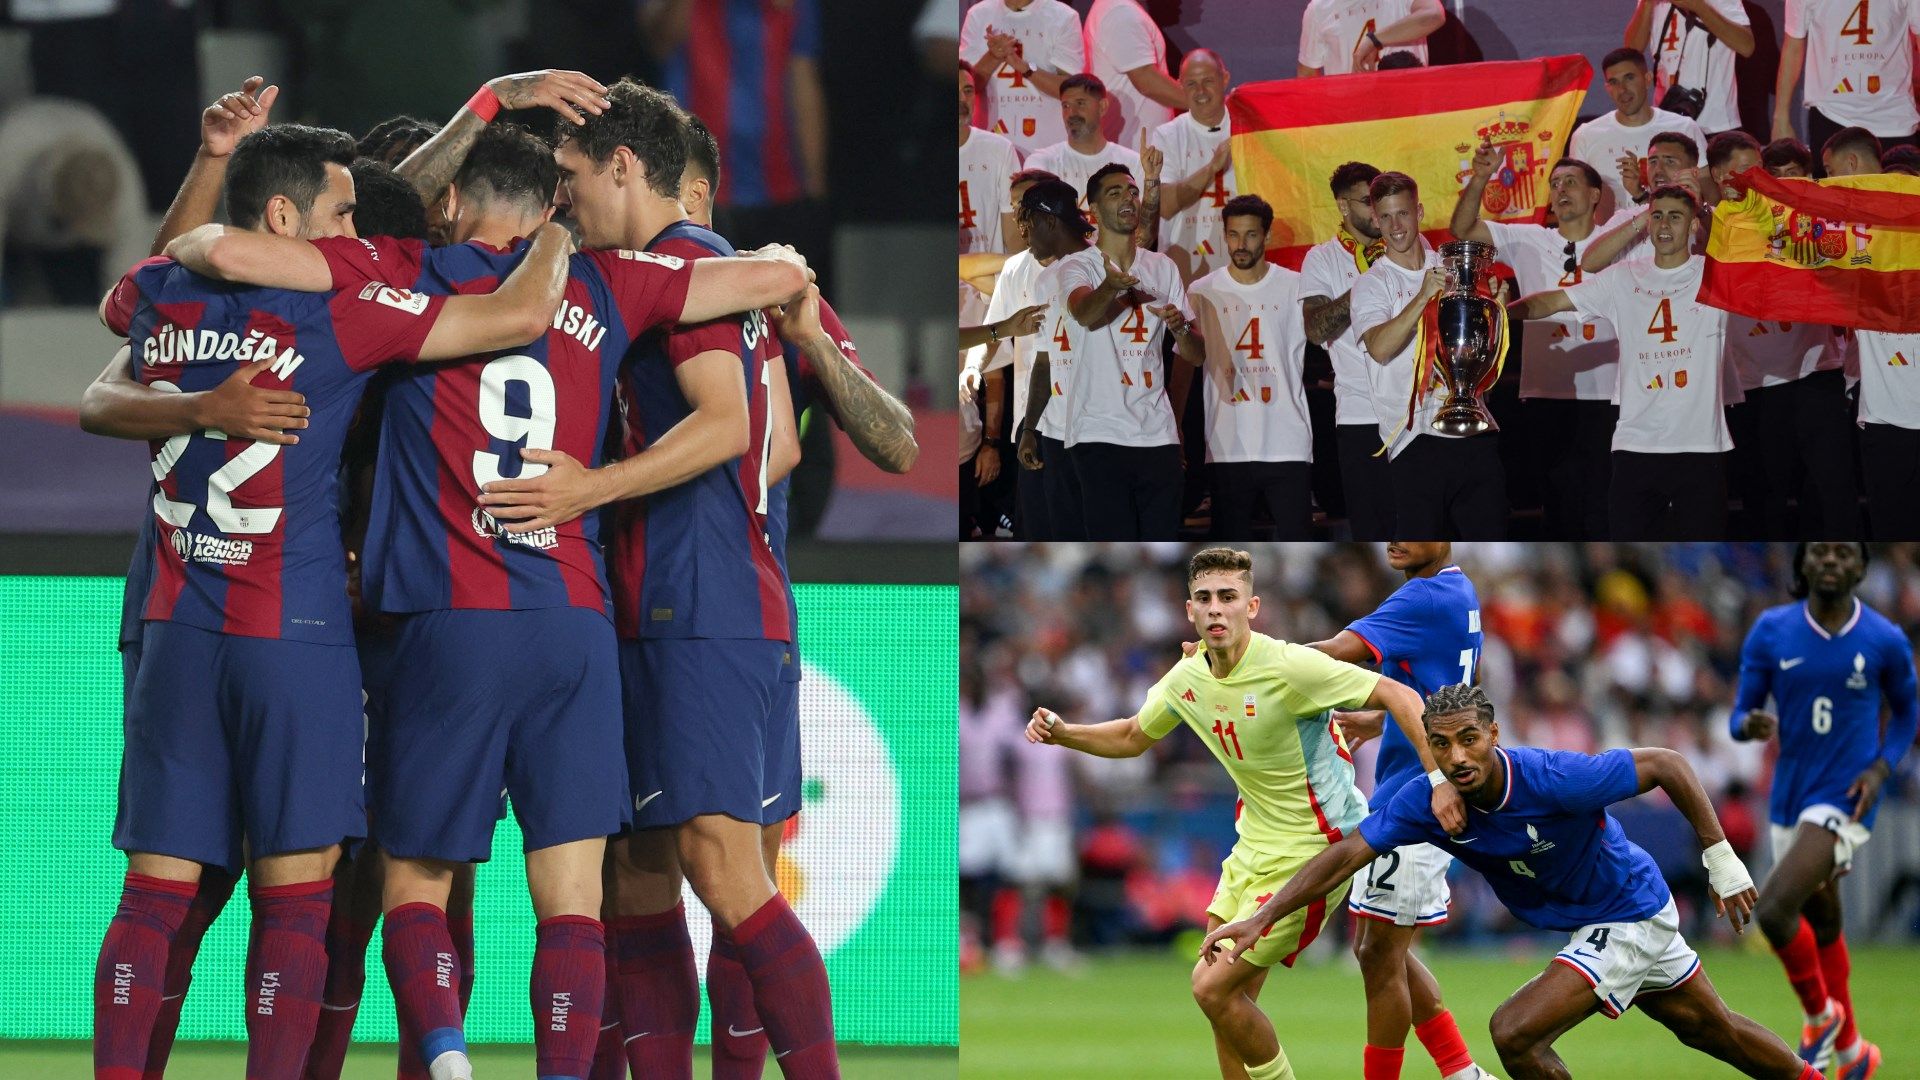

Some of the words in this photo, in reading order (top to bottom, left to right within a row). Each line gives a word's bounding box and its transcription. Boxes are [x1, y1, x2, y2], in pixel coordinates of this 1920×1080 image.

[1840, 0, 1874, 46] 4
[1120, 303, 1149, 343] 4
[1223, 303, 1280, 314] REYES
[1648, 298, 1678, 344] 4
[1235, 316, 1265, 360] 4
[1638, 351, 1650, 360] DE
[1654, 347, 1692, 360] EUROPA
[472, 354, 557, 495] 9
[193, 544, 251, 561] ACNUR
[194, 533, 253, 554] UNHCR
[1812, 695, 1834, 736] 6
[1212, 719, 1244, 761] 11
[1367, 850, 1401, 891] 12
[1508, 860, 1536, 879] 4
[1585, 927, 1610, 953] 4
[113, 963, 134, 1005] BARÇA
[437, 952, 454, 989] BARÇA
[257, 971, 280, 1016] BARÇA
[550, 991, 571, 1032] BARÇA
